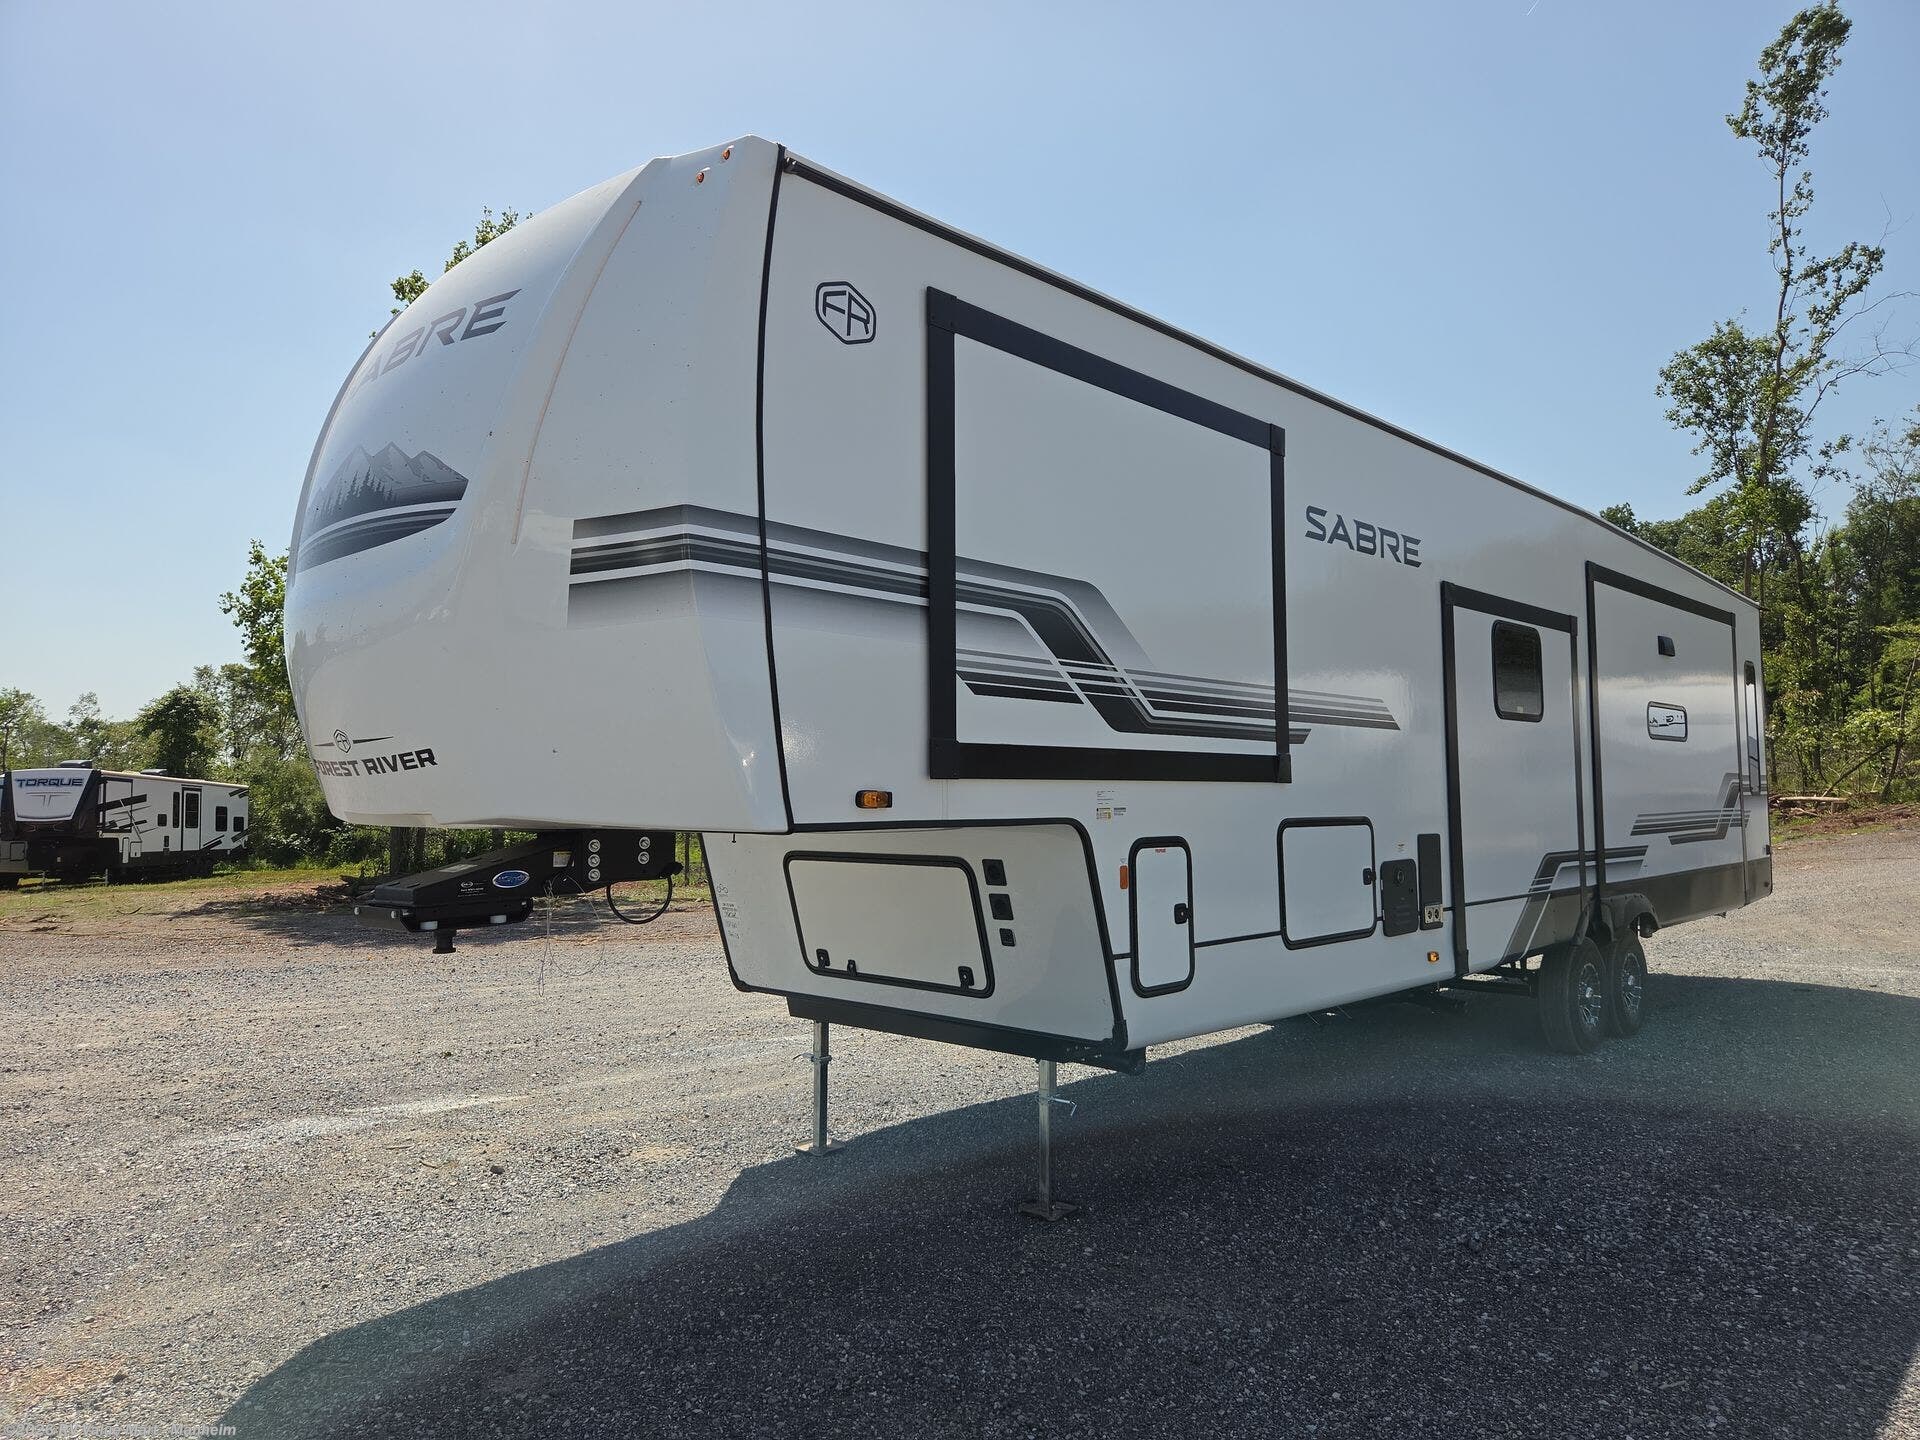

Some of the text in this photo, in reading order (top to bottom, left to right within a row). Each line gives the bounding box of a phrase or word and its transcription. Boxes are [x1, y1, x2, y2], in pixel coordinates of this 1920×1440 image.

[346, 288, 522, 399] ABRE
[1305, 505, 1422, 568] SABRE
[16, 778, 84, 788] TORQUE
[361, 748, 437, 776] RIVER
